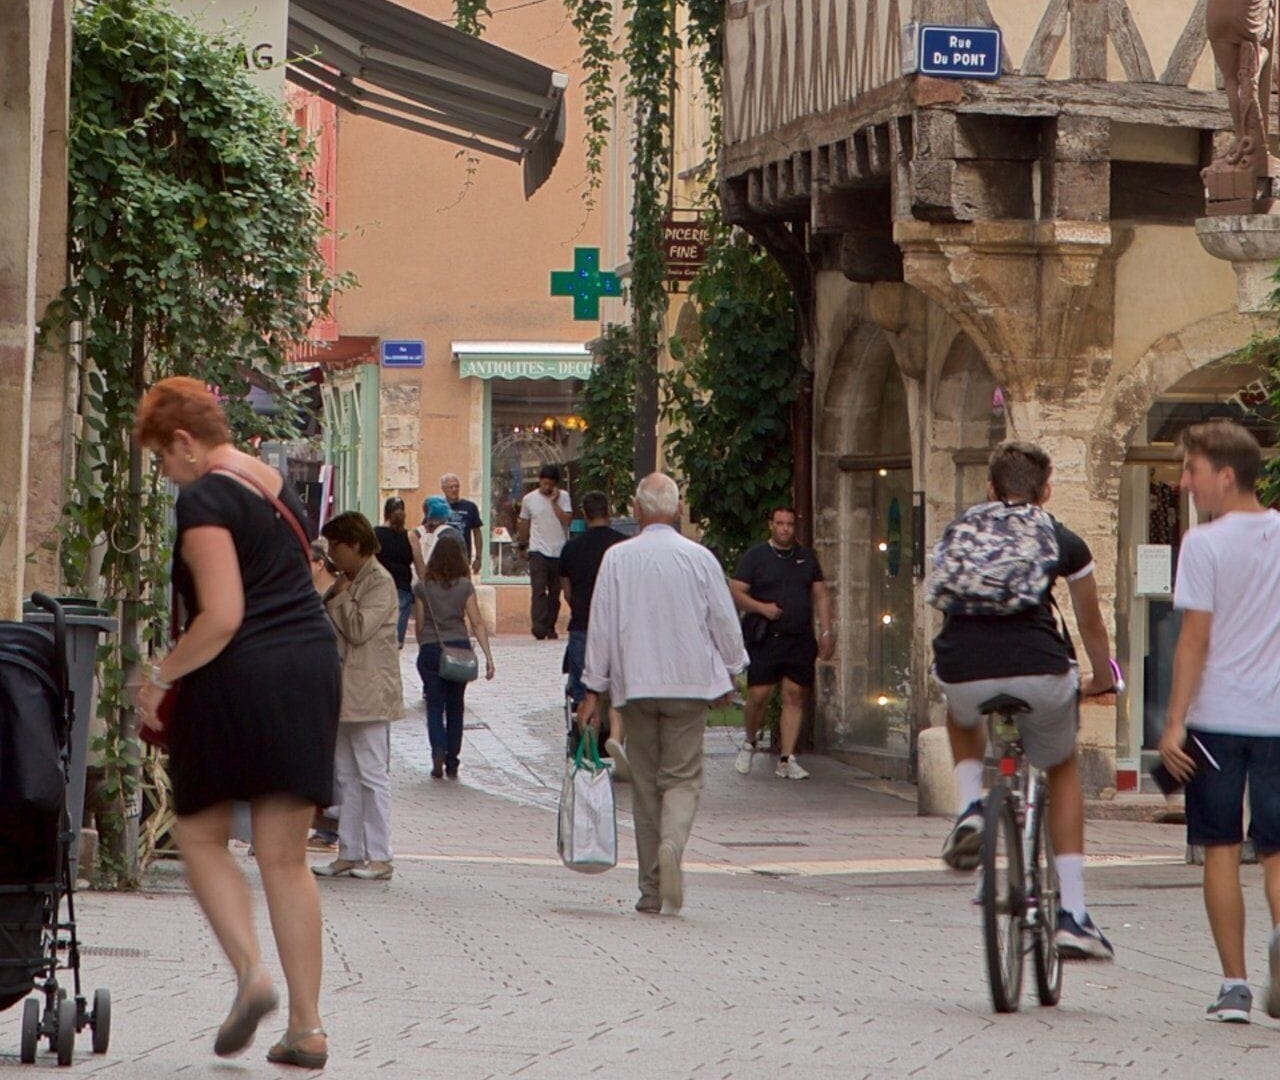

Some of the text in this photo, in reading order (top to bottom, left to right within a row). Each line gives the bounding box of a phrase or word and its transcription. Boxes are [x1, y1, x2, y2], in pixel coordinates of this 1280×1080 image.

[949, 35, 972, 49] Rue
[933, 52, 986, 66] Du PONT
[665, 228, 711, 245] PICERIE
[670, 245, 698, 259] FINE
[467, 360, 544, 376] ANTIQUITES
